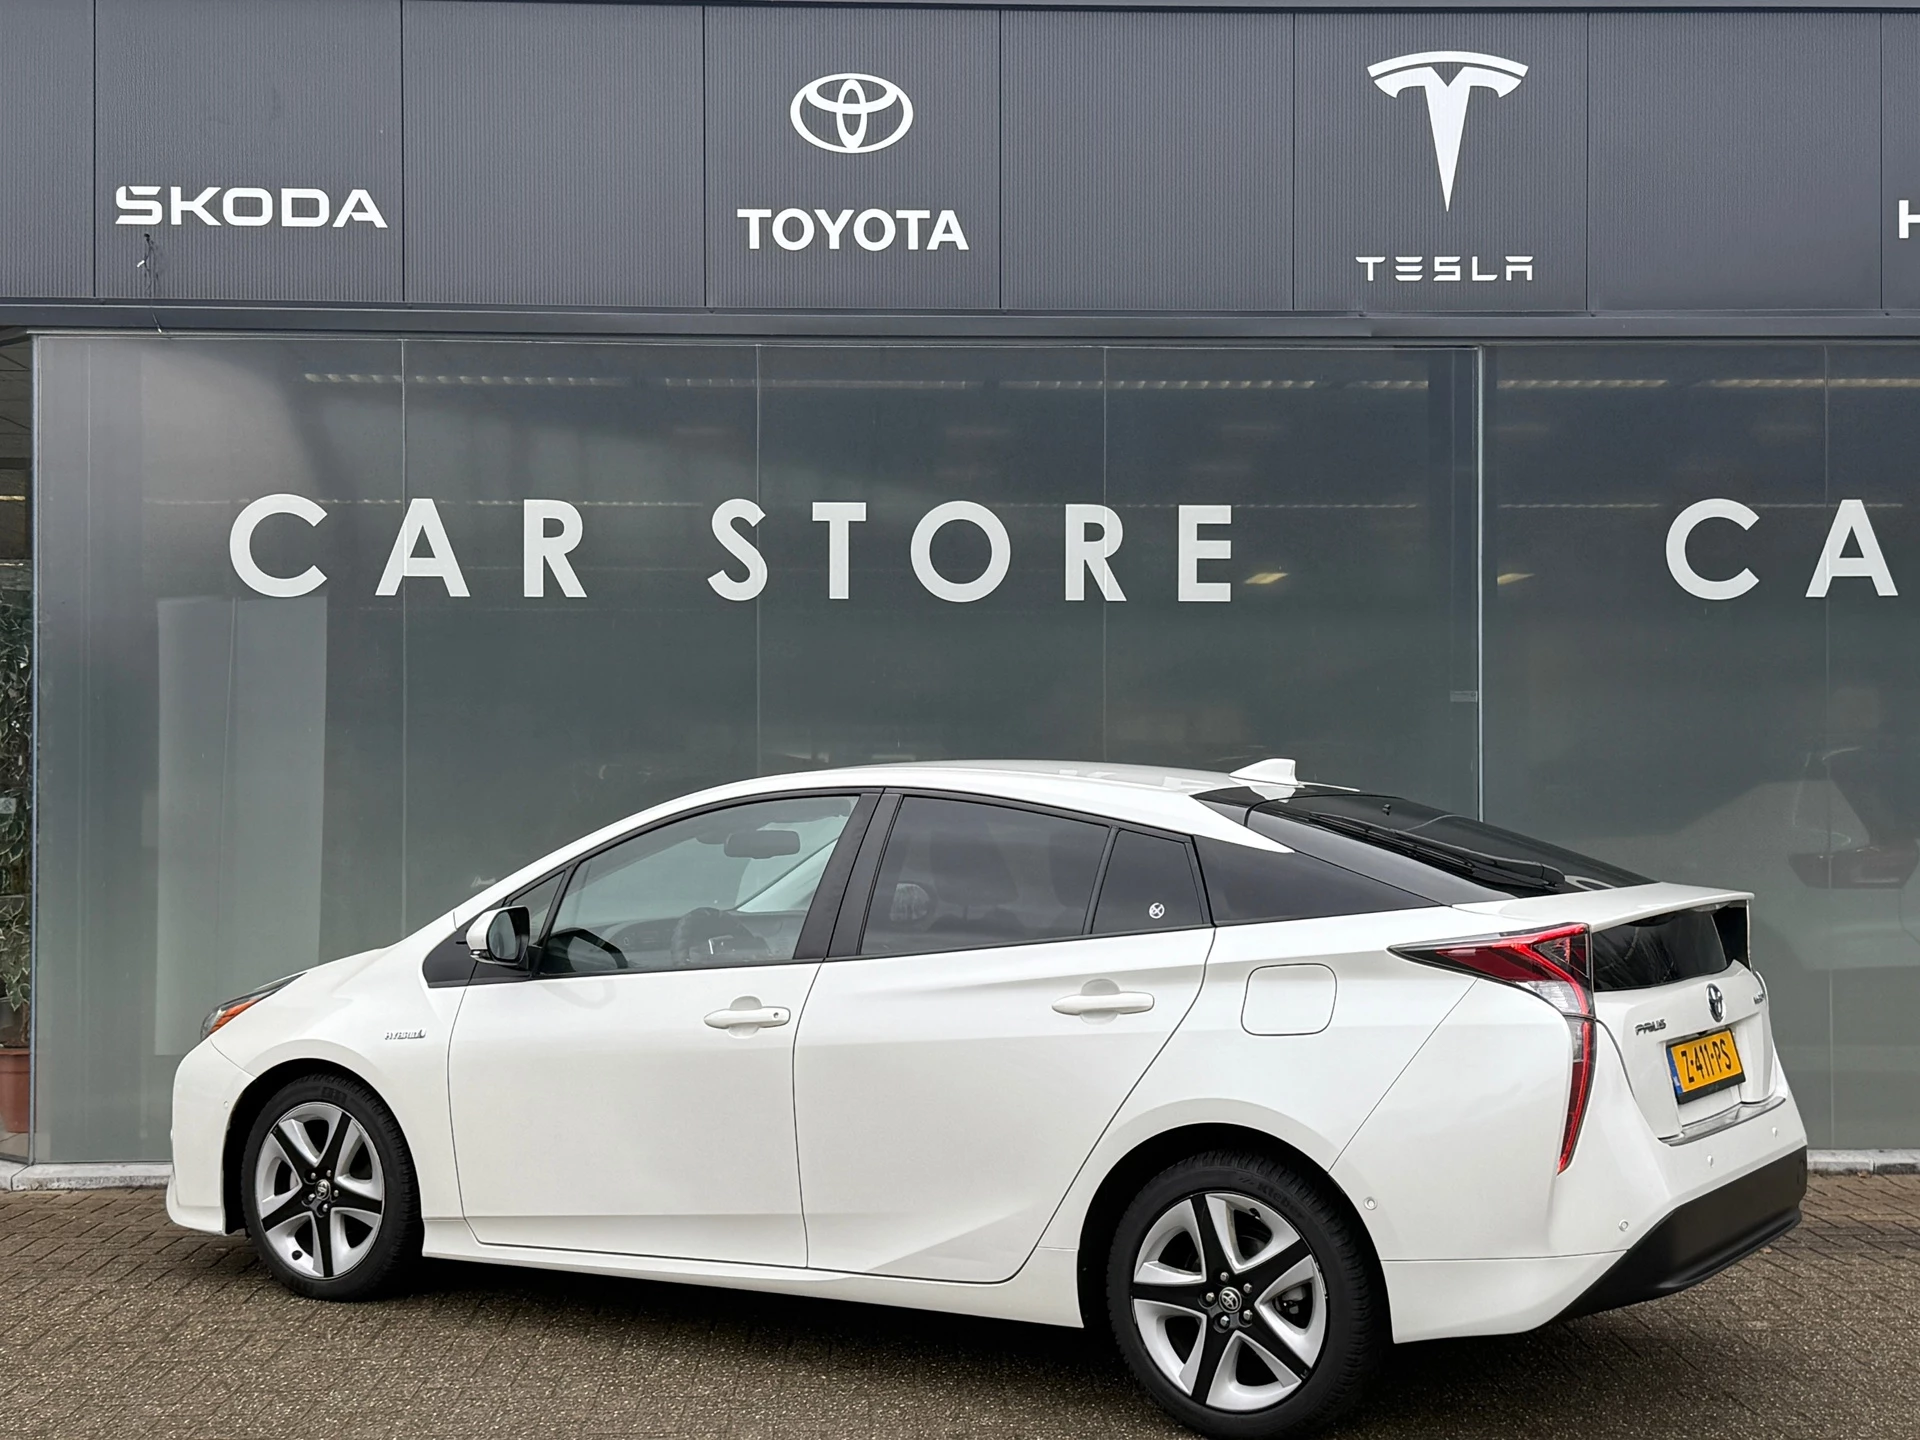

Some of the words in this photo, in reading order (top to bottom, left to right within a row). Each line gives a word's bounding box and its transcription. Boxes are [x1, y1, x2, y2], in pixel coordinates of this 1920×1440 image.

[115, 185, 388, 229] SKODA
[736, 207, 970, 252] TOYOTA
[1355, 255, 1534, 282] TESLA
[229, 493, 588, 598] CAR
[708, 498, 1232, 603] STORE
[1665, 498, 1899, 600] CA
[1634, 1018, 1667, 1036] PRIUS
[1680, 1038, 1732, 1084] Z-411-PS
